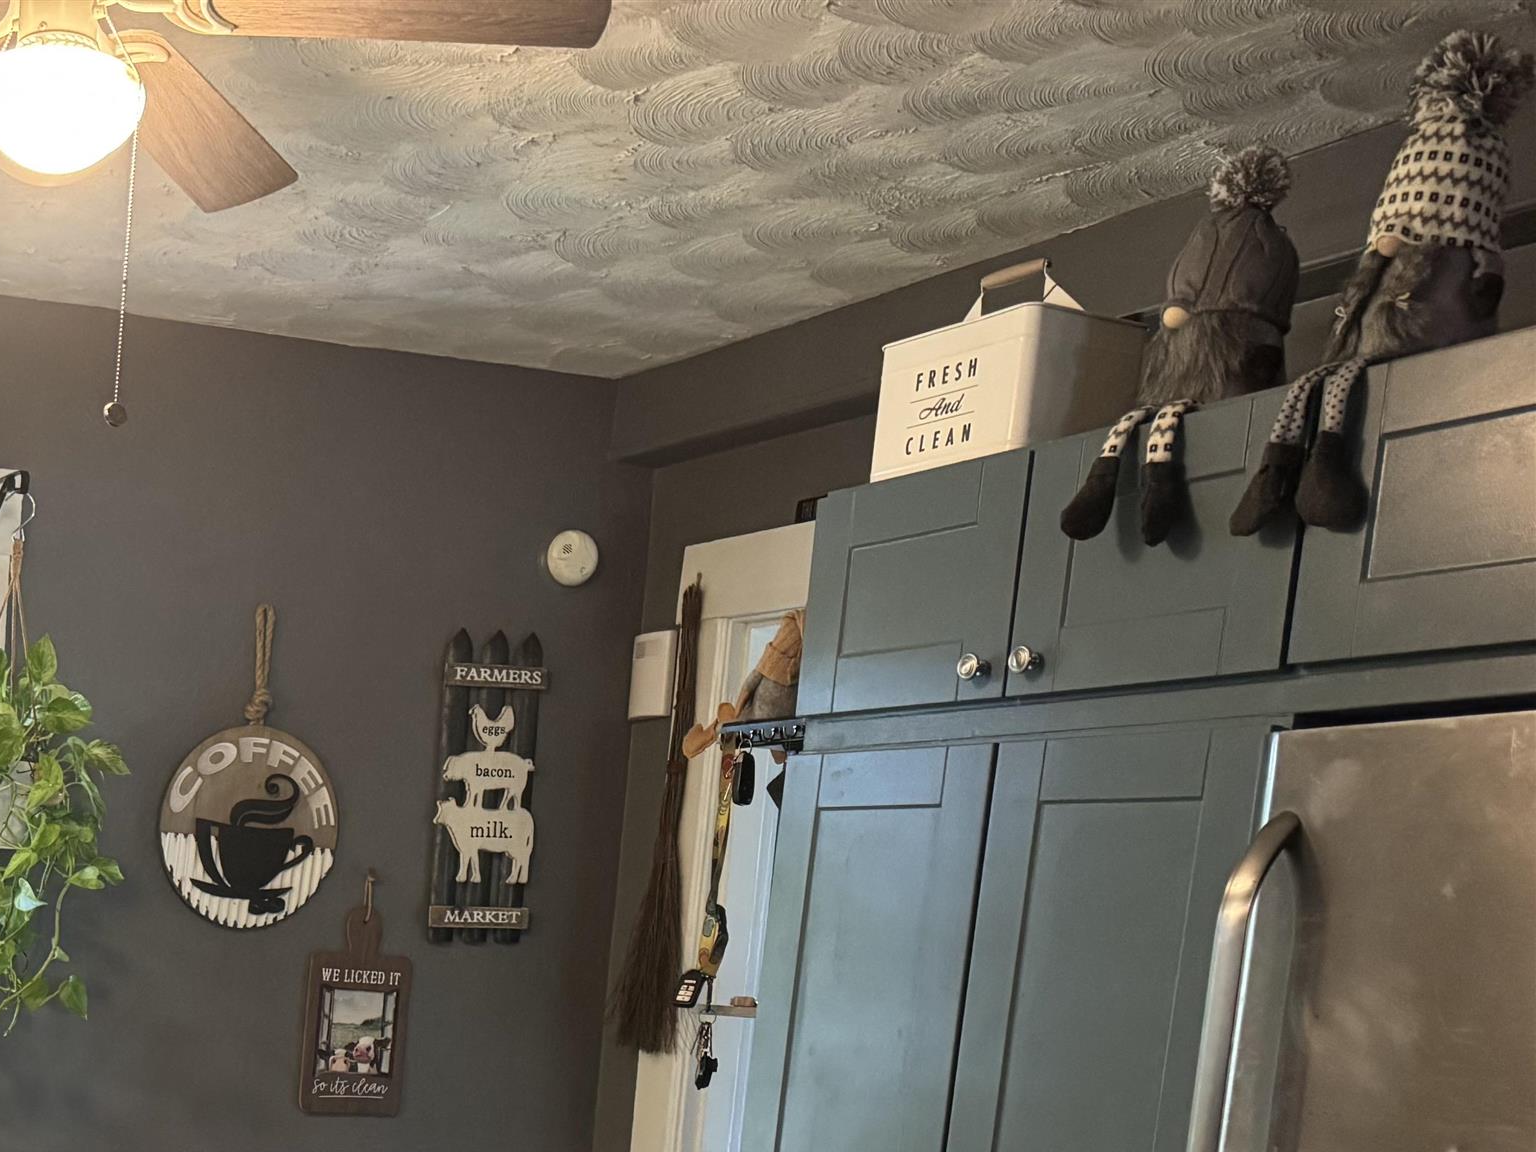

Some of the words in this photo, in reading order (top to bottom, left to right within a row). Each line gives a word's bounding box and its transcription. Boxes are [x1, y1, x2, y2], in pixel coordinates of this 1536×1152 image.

[915, 357, 978, 392] FRESH
[918, 393, 965, 420] And
[905, 422, 972, 456] CLEAN
[454, 666, 543, 685] FARMERS
[474, 763, 516, 779] bacon.
[169, 736, 336, 829] COFFEE
[469, 820, 513, 840] milk.
[443, 909, 521, 925] MARKET
[322, 967, 341, 982] WE
[344, 968, 386, 985] LICKED
[389, 972, 401, 986] IT
[351, 1077, 389, 1095] clean
